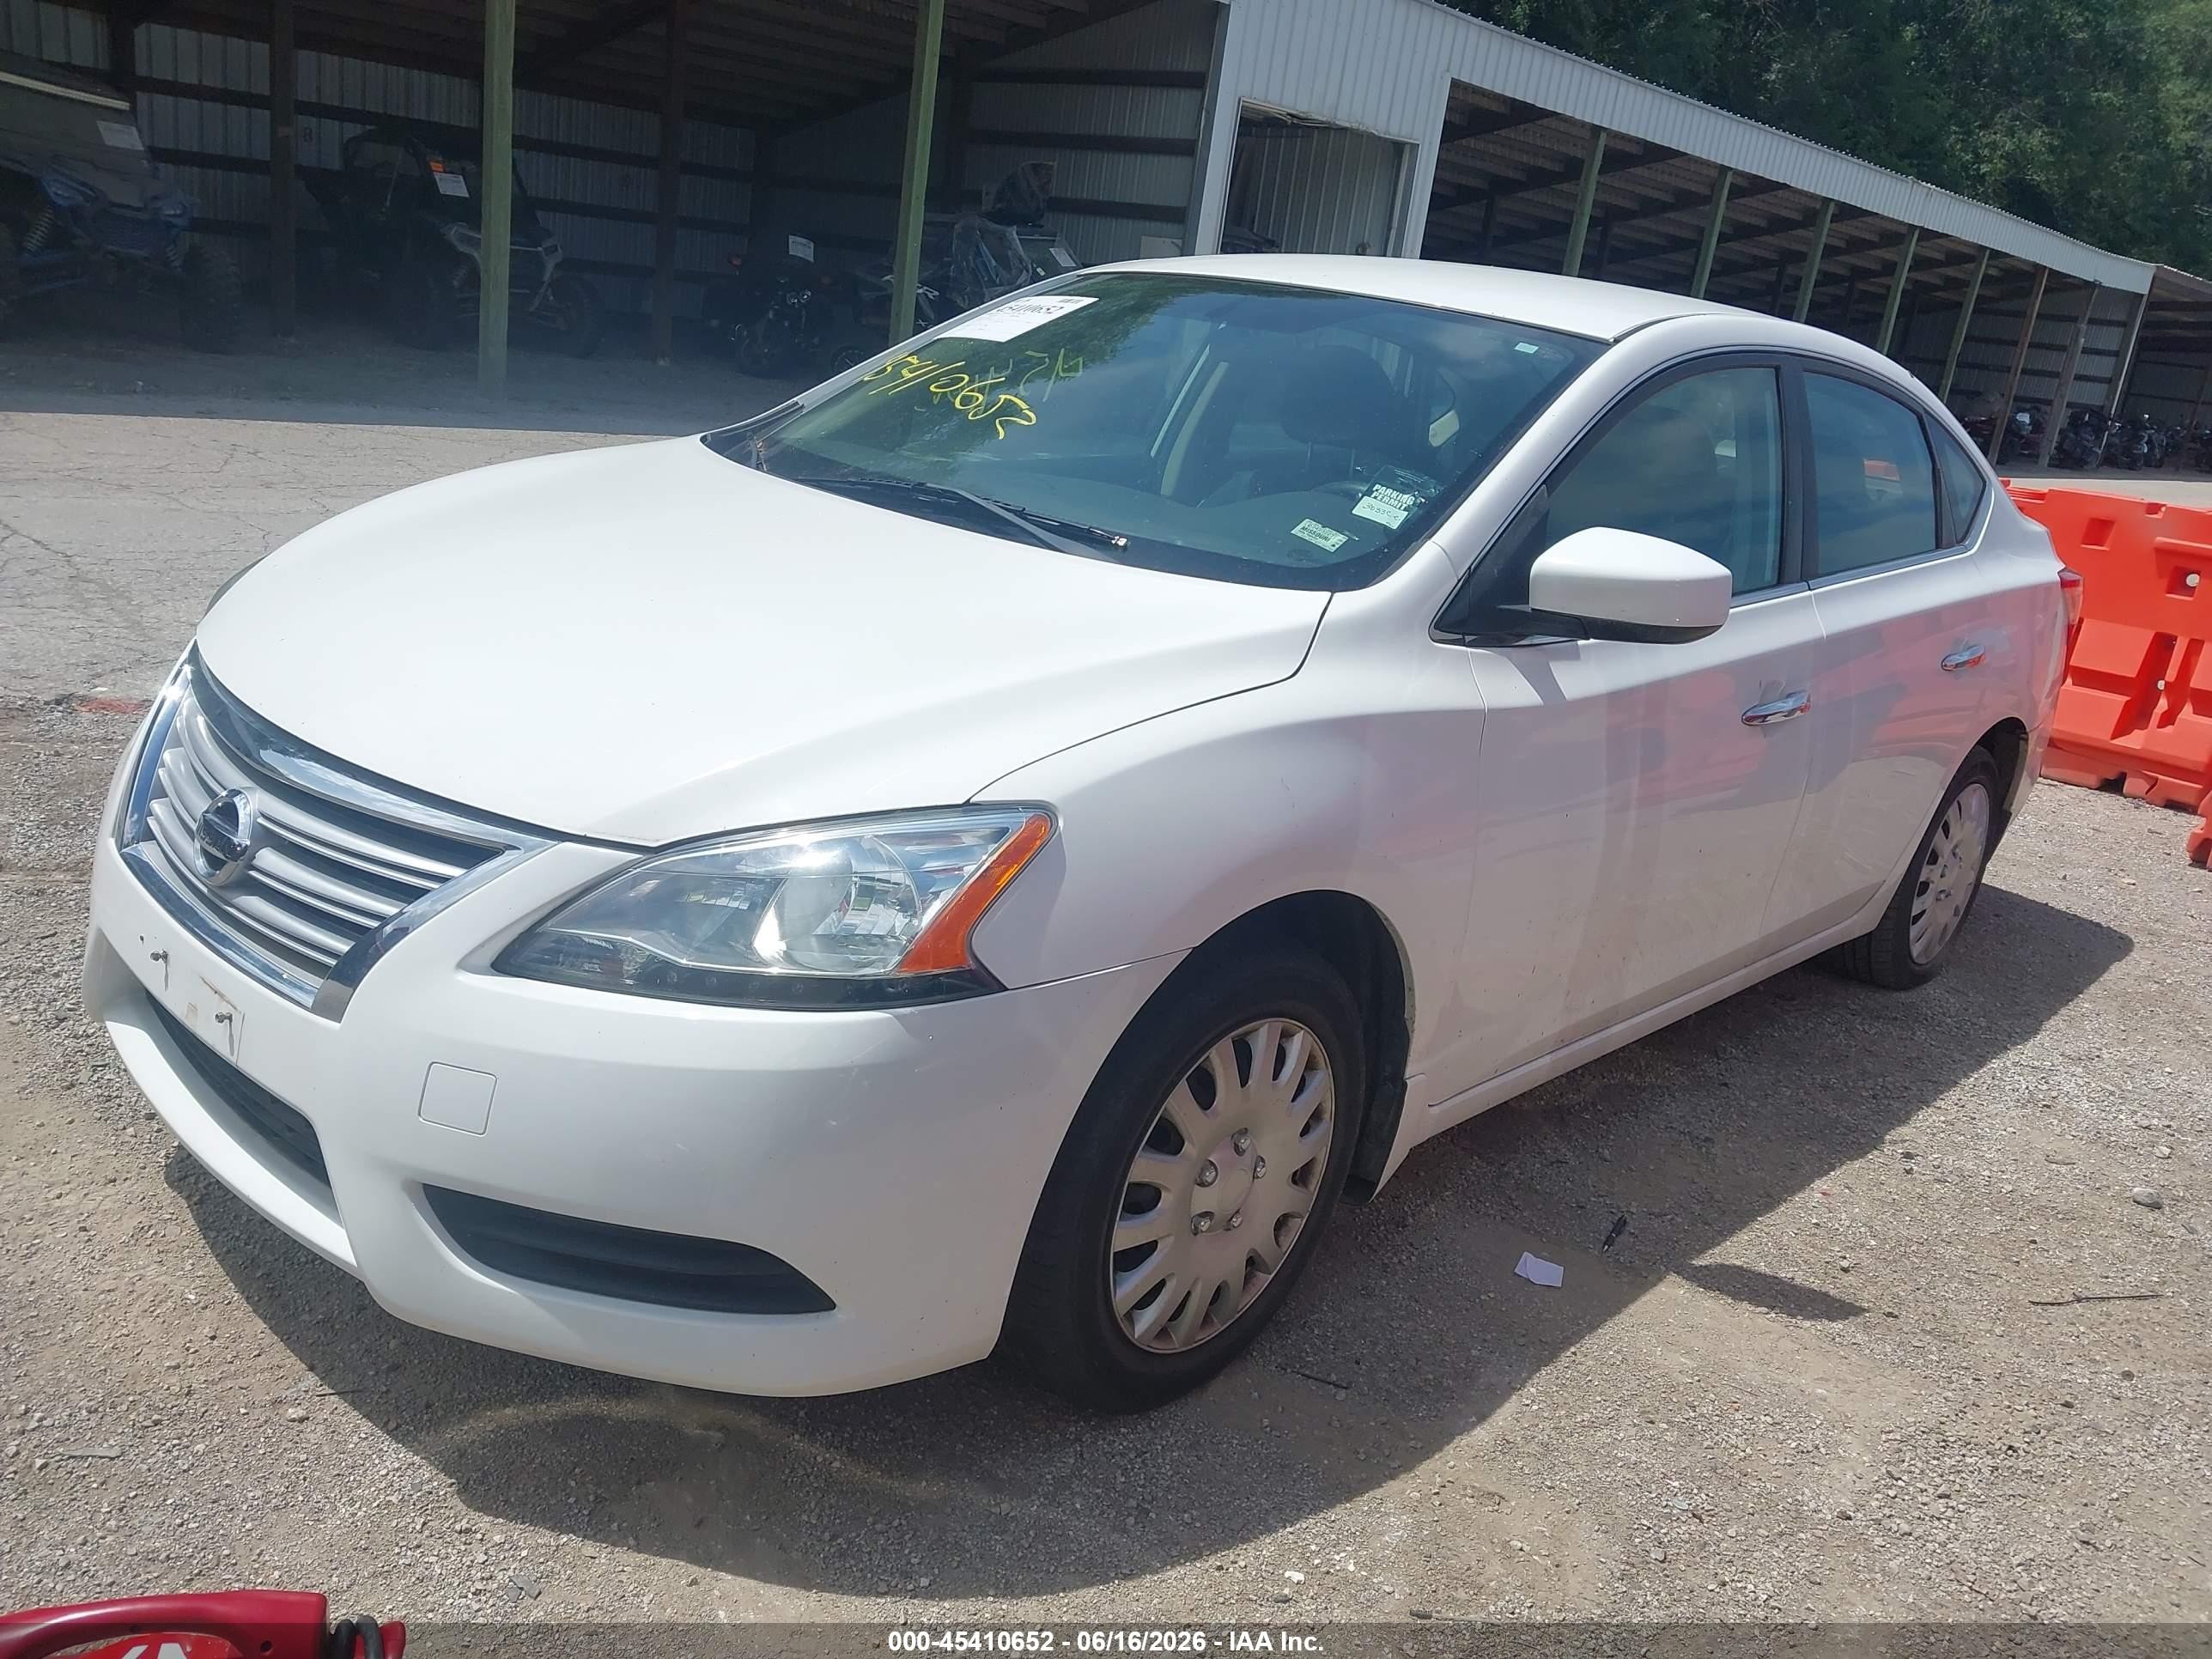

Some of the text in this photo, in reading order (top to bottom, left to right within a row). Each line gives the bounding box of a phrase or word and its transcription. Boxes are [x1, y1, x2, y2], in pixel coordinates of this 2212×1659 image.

[1370, 491, 1409, 511] PERMIT
[1372, 483, 1415, 505] PARKING
[1300, 526, 1332, 543] MISSOURI
